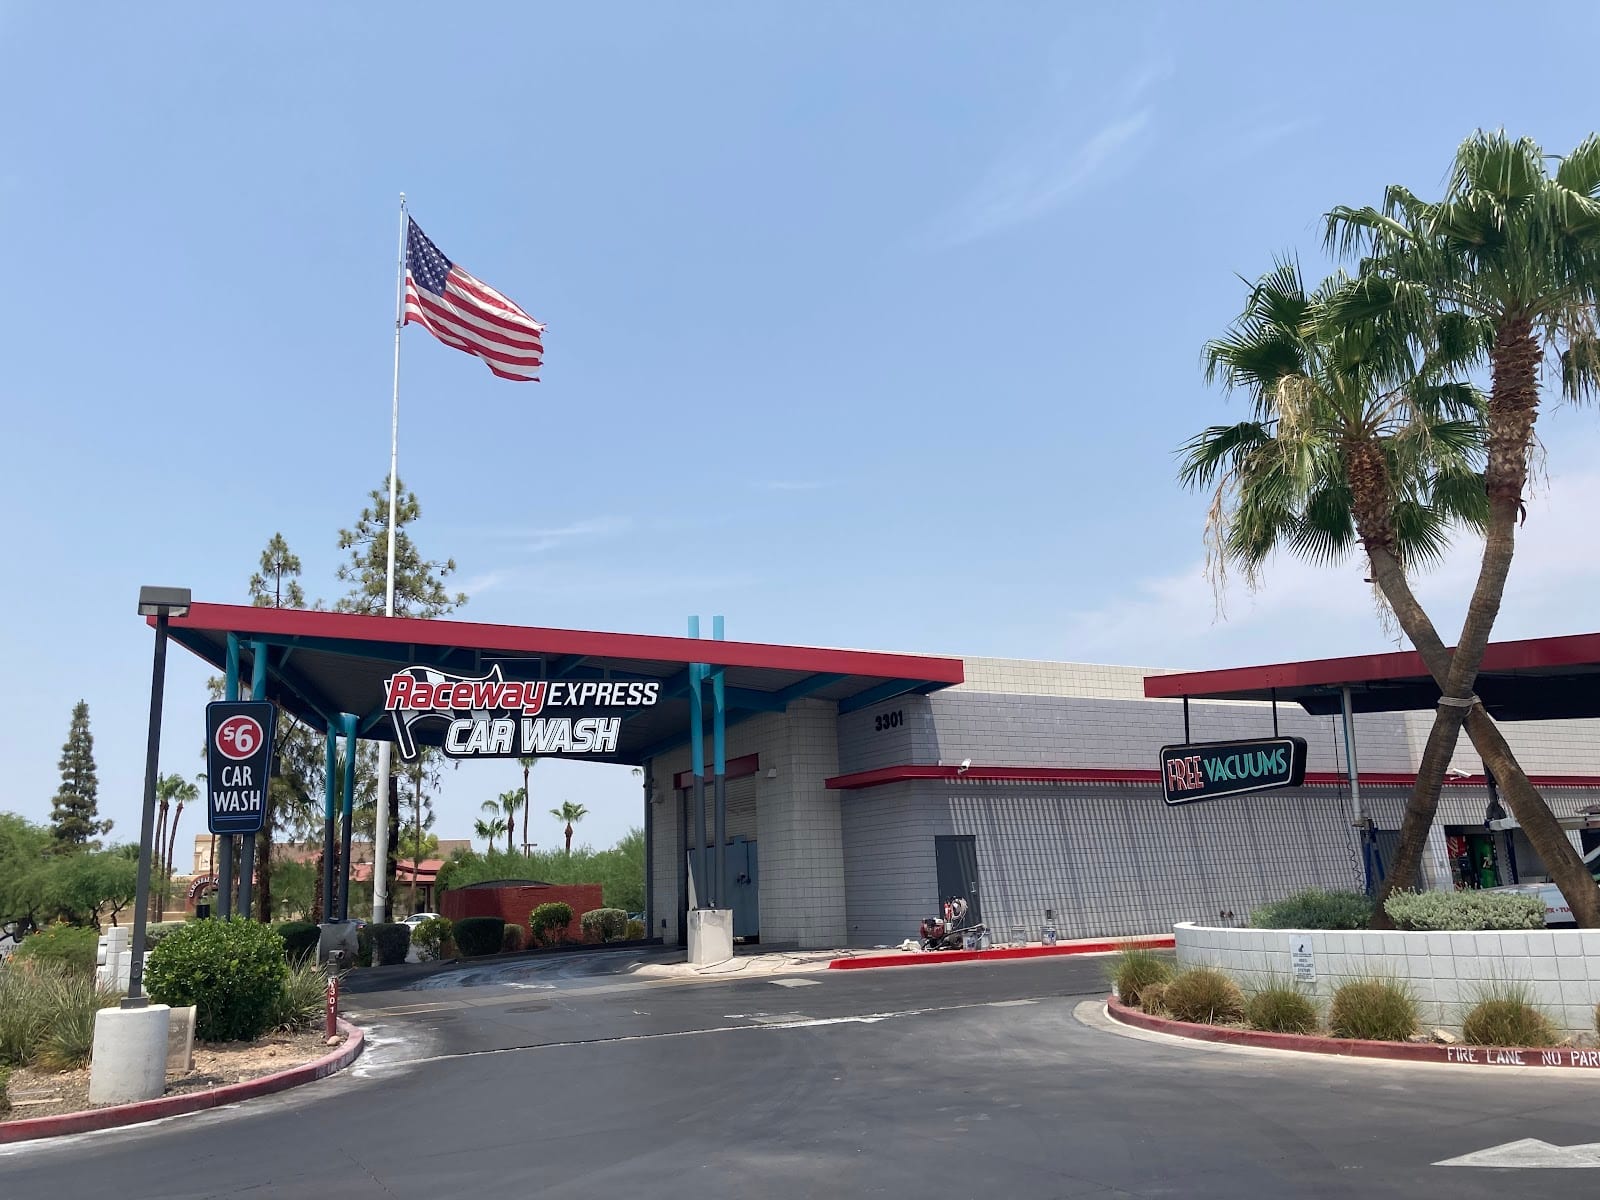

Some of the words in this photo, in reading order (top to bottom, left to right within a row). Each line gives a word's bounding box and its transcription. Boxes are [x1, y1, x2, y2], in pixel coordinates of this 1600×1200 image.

[384, 673, 548, 716] Raceway
[547, 682, 659, 706] EXPRESS
[875, 709, 904, 731] 3301
[223, 724, 254, 752] $6
[445, 717, 515, 754] CAR
[521, 717, 621, 754] WASH
[221, 765, 253, 787] CAR
[1166, 755, 1204, 792] FREE
[1203, 748, 1287, 783] VACUUMS
[213, 790, 260, 812] WASH
[1447, 1047, 1478, 1063] FIRE
[1486, 1049, 1526, 1065] LANE
[1542, 1051, 1561, 1066] NO
[1570, 1051, 1600, 1067] PAR
